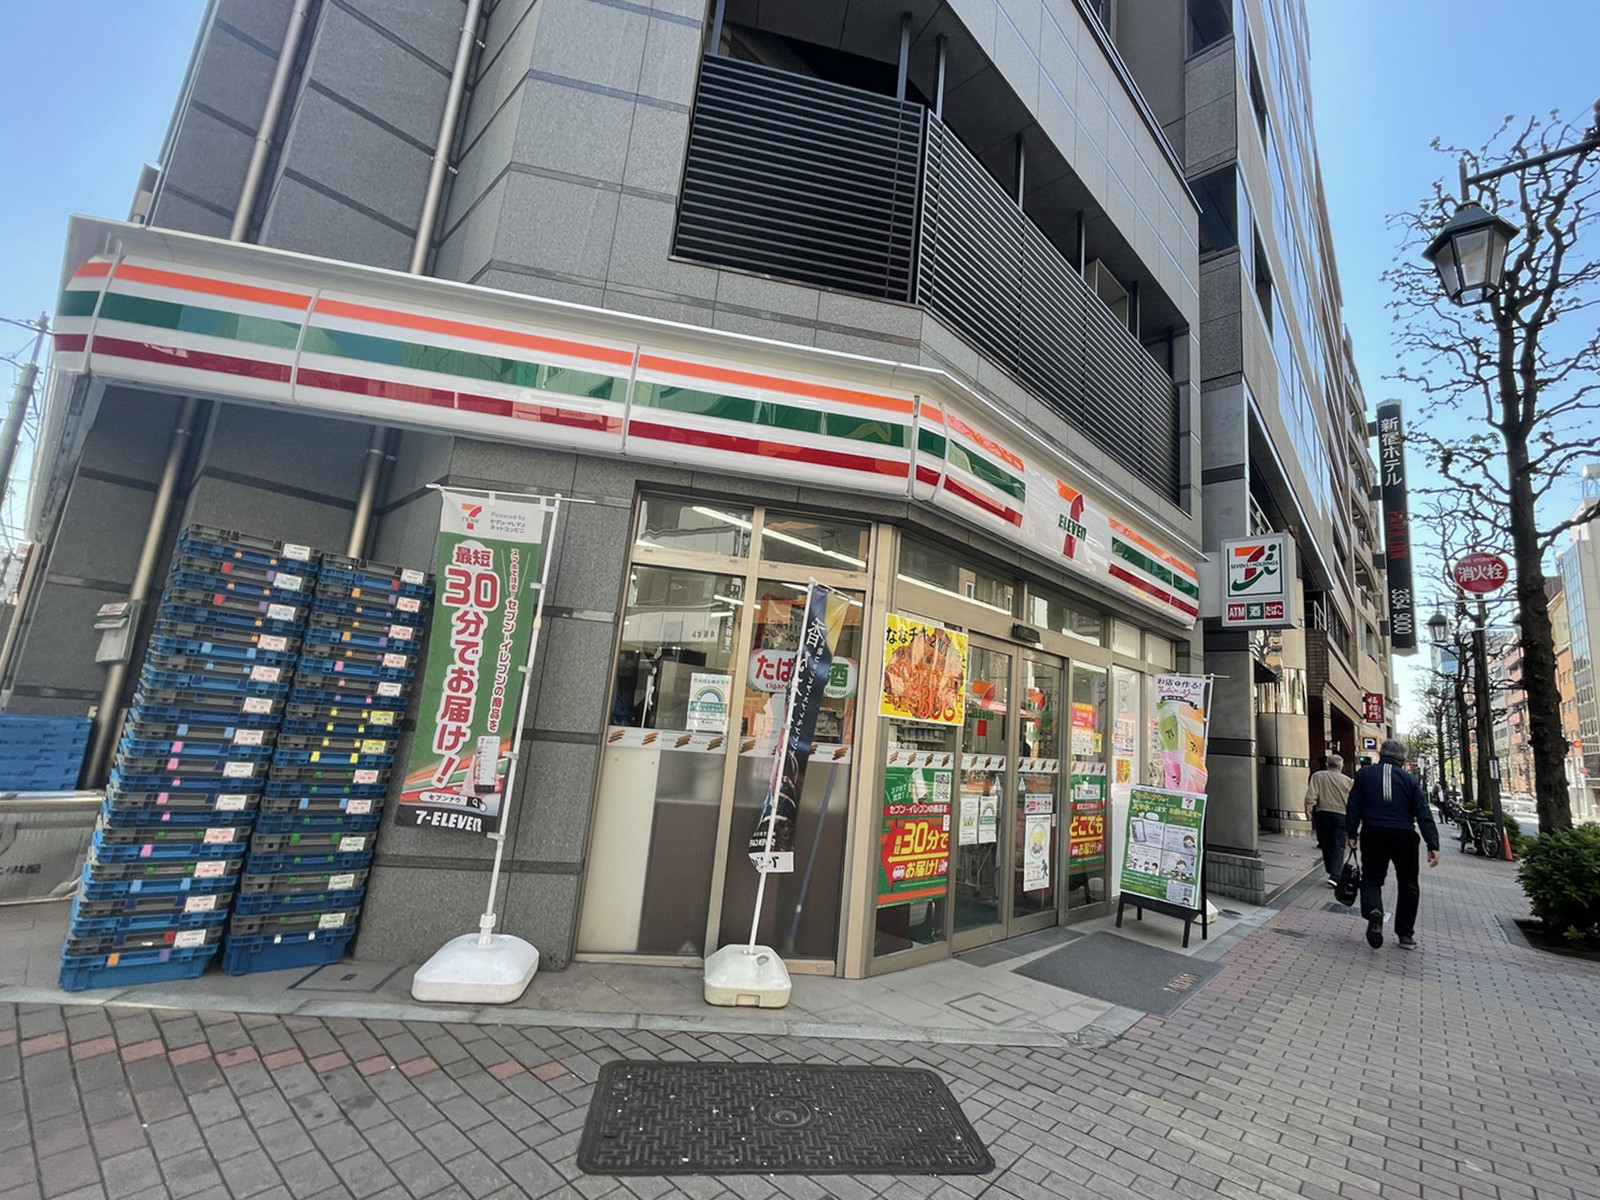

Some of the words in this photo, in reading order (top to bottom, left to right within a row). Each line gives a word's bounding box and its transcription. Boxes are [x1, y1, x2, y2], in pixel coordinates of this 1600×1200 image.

[1381, 416, 1402, 487] 新宿ホテル
[455, 546, 491, 567] 最短
[1457, 563, 1505, 582] 消火栓
[445, 568, 498, 609] 30
[1391, 588, 1410, 609] 3354
[1229, 606, 1245, 618] ATM
[1249, 605, 1262, 617] 酒
[1265, 604, 1283, 616] たばこ
[1393, 613, 1412, 635] 9000
[1363, 737, 1375, 749] P
[429, 794, 461, 803] セブンナウ
[1069, 815, 1103, 837] どこでも
[905, 859, 939, 879] お届け!
